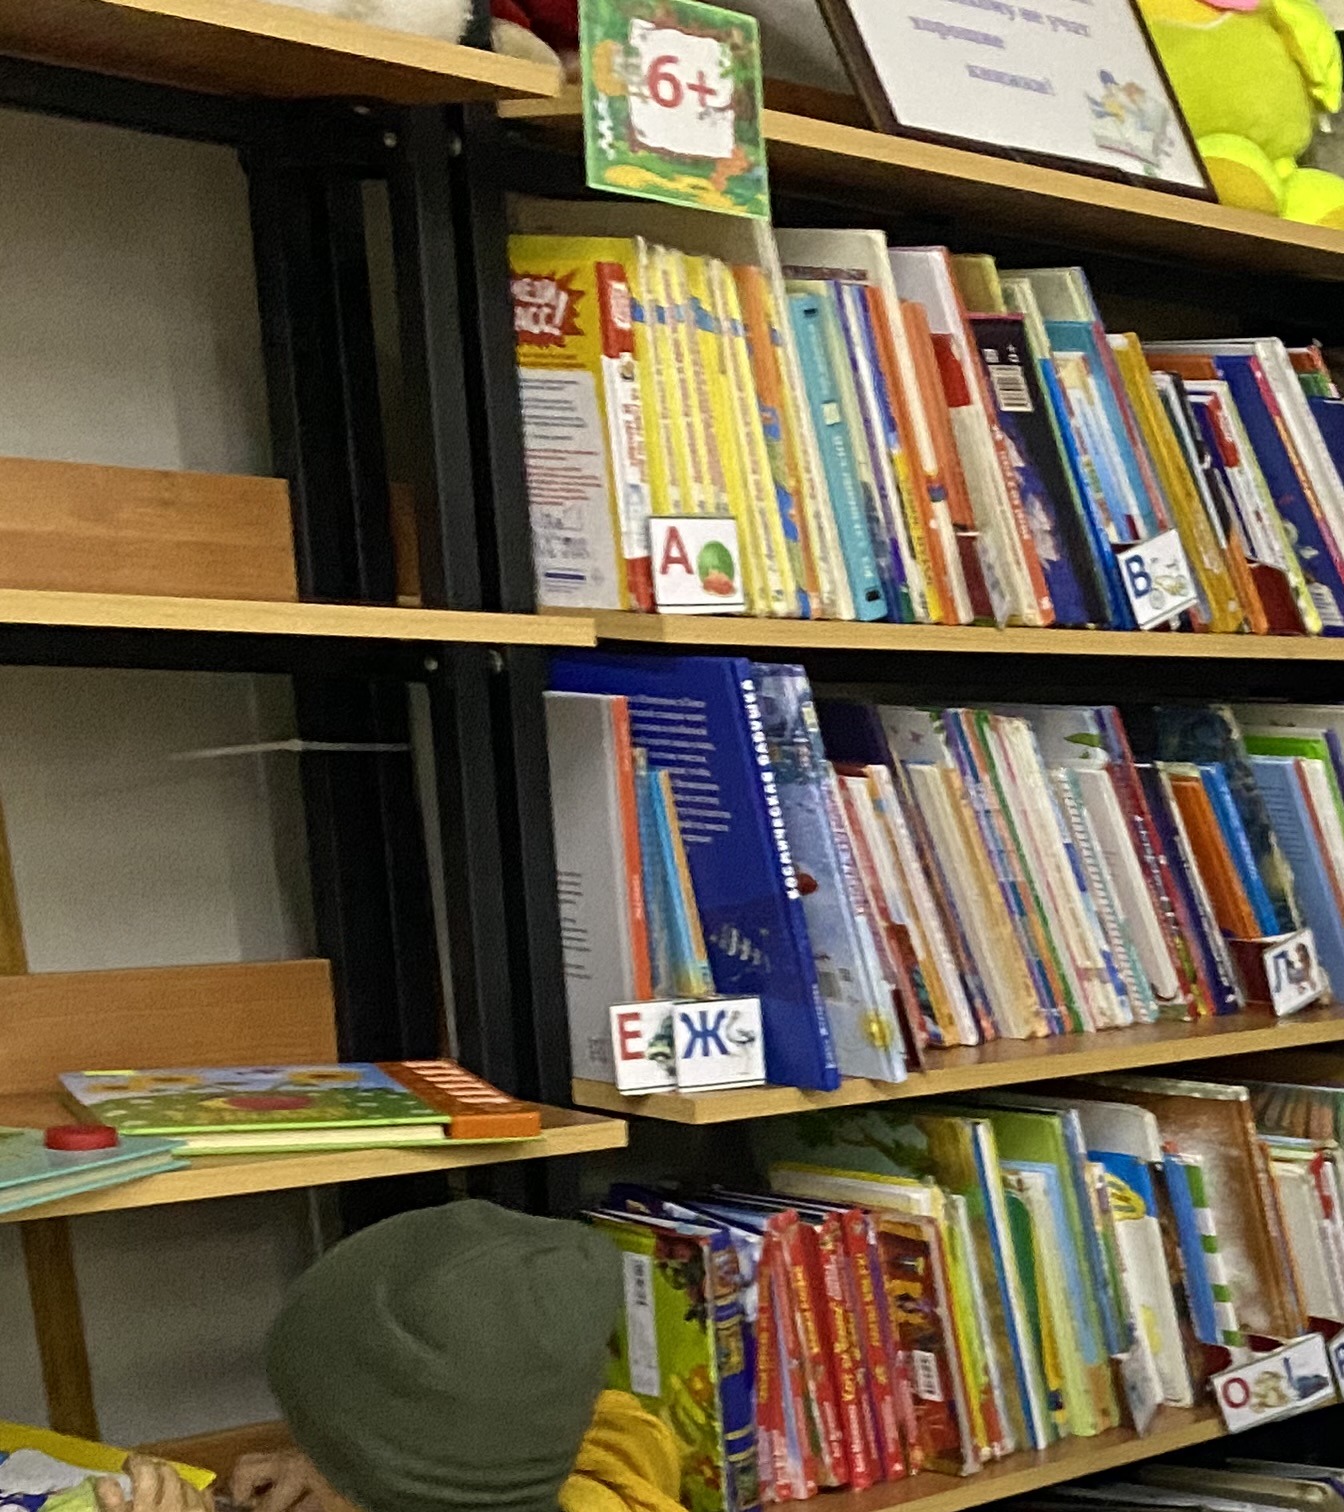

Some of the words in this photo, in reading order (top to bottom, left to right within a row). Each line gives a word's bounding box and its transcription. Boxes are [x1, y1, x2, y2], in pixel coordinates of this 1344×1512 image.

[646, 55, 718, 110] 6+
[659, 525, 695, 576] А
[1126, 542, 1155, 598] В
[619, 1012, 643, 1061] Е
[679, 1010, 731, 1059] Ж
